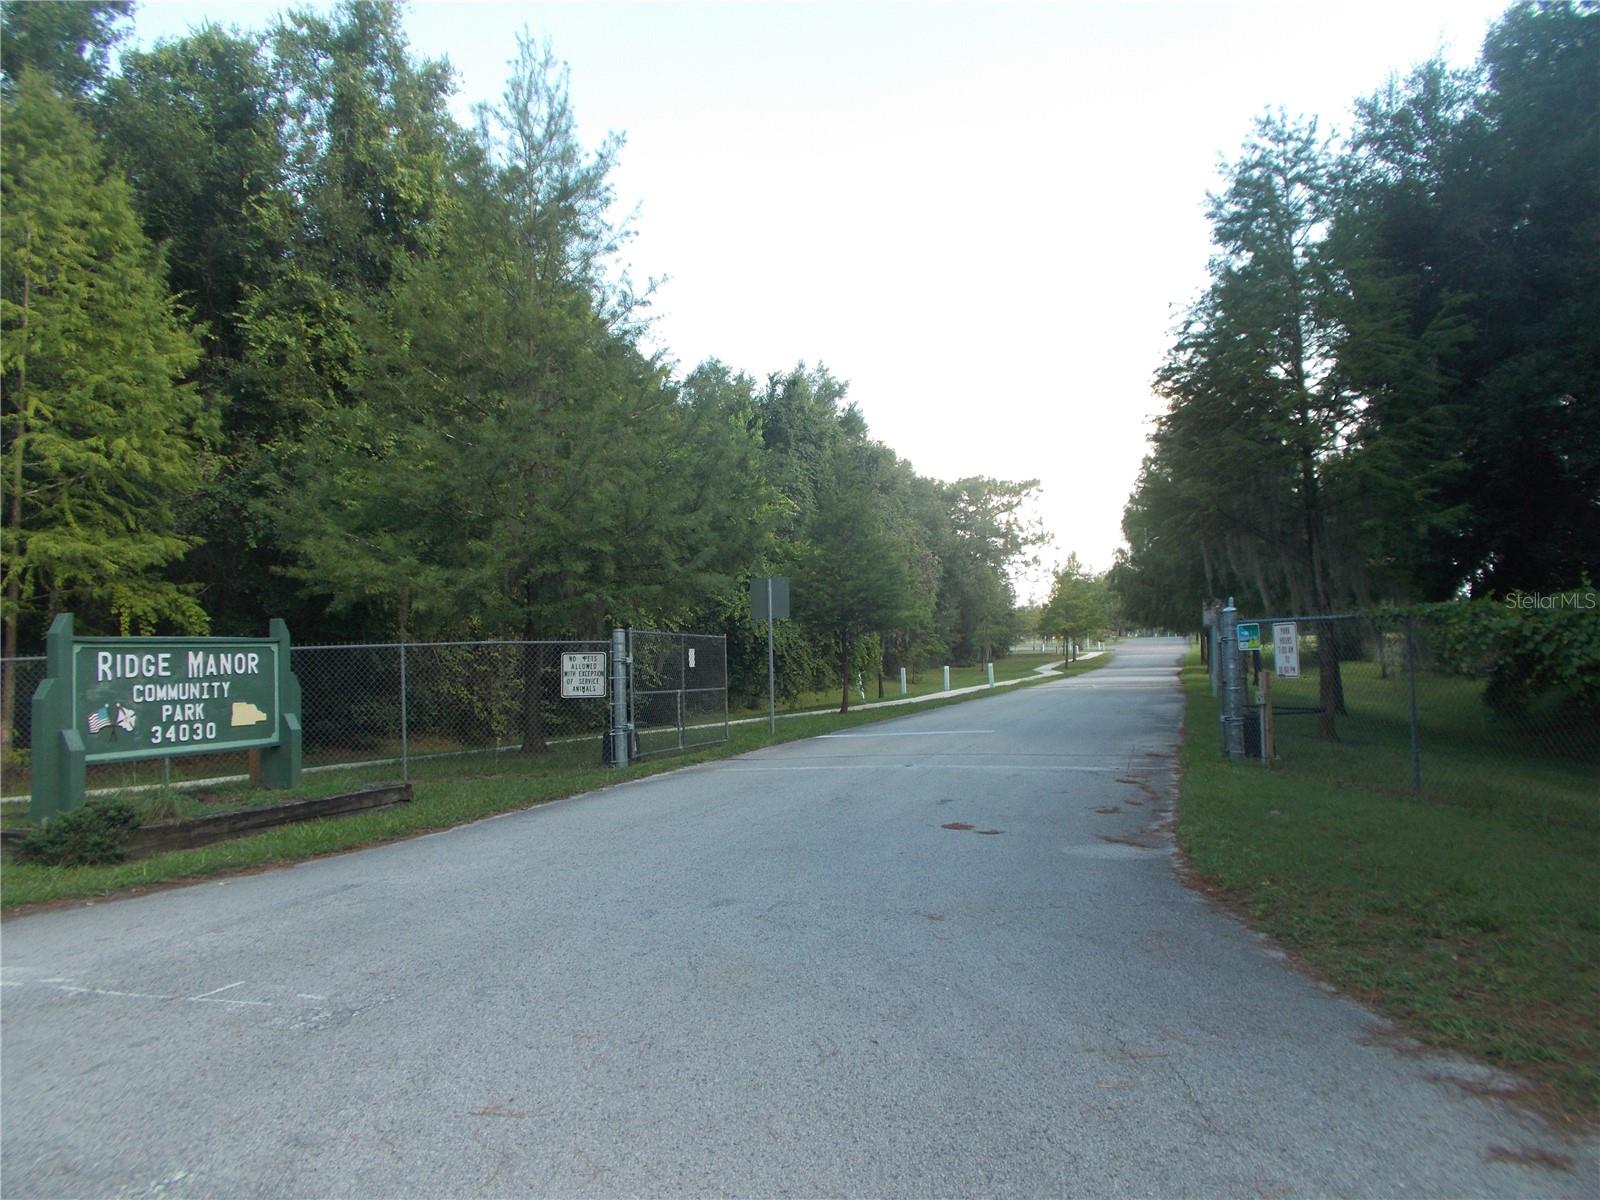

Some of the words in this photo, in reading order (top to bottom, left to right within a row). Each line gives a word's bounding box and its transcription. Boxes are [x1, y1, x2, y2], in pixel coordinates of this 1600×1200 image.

[97, 651, 172, 681] RIDGE
[187, 651, 259, 678] MANOR
[133, 682, 230, 703] COMMUNITY
[162, 703, 205, 722] PARK
[151, 722, 217, 744] 34030
